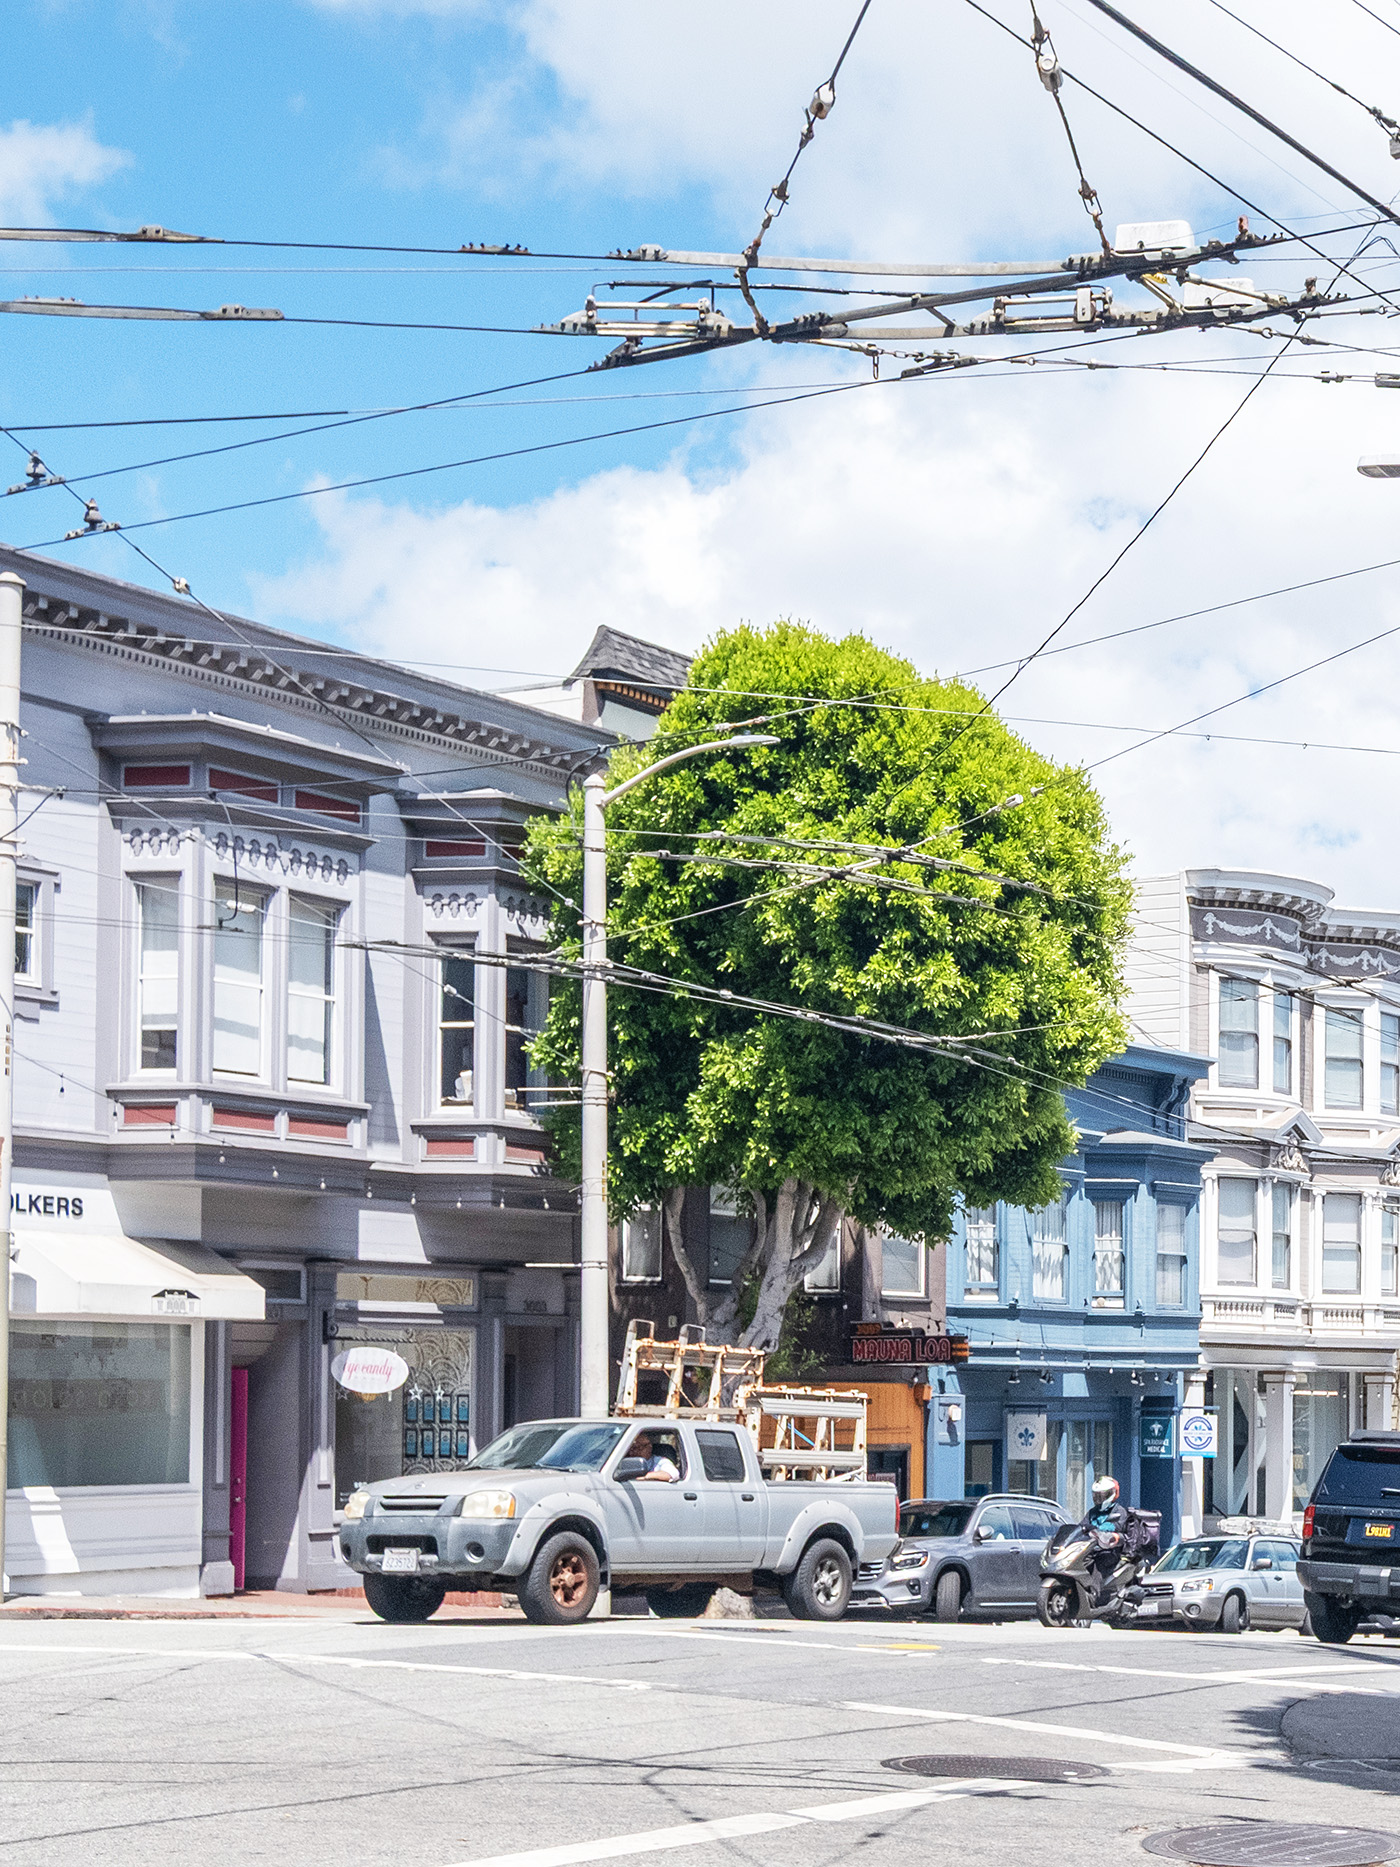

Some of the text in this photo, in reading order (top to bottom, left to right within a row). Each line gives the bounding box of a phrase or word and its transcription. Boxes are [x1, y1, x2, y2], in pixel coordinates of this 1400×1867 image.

[11, 1193, 83, 1216] LKERS
[853, 1338, 951, 1361] MAUNA LOA
[361, 1358, 393, 1383] candy
